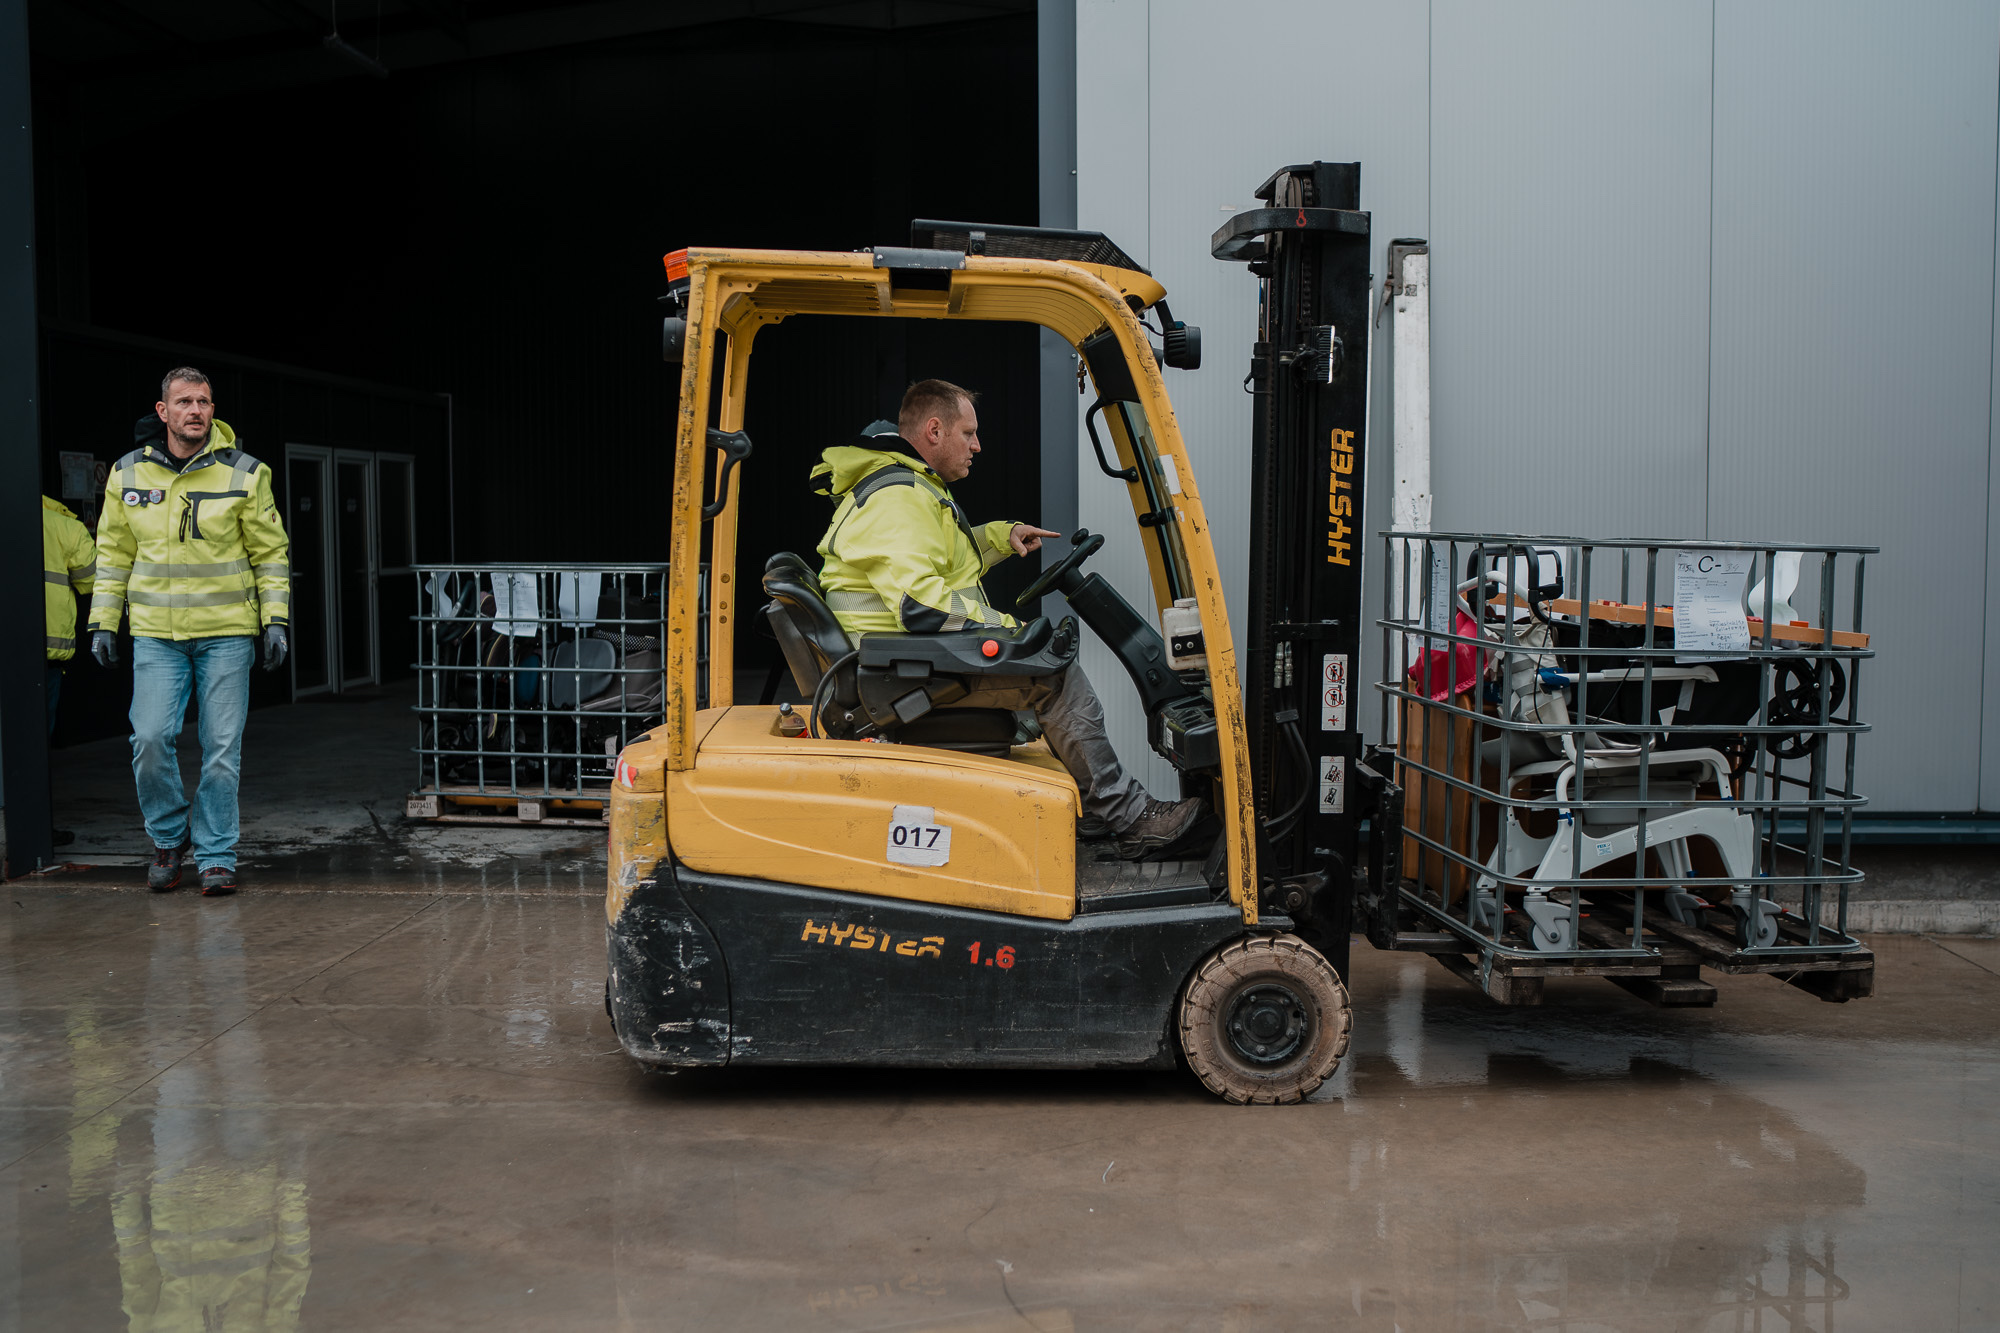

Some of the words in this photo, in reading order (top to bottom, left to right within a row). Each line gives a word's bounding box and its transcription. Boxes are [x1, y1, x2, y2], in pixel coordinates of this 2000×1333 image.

[1327, 428, 1355, 566] HYSTER
[892, 825, 941, 848] 017
[968, 941, 1016, 969] 1.6
